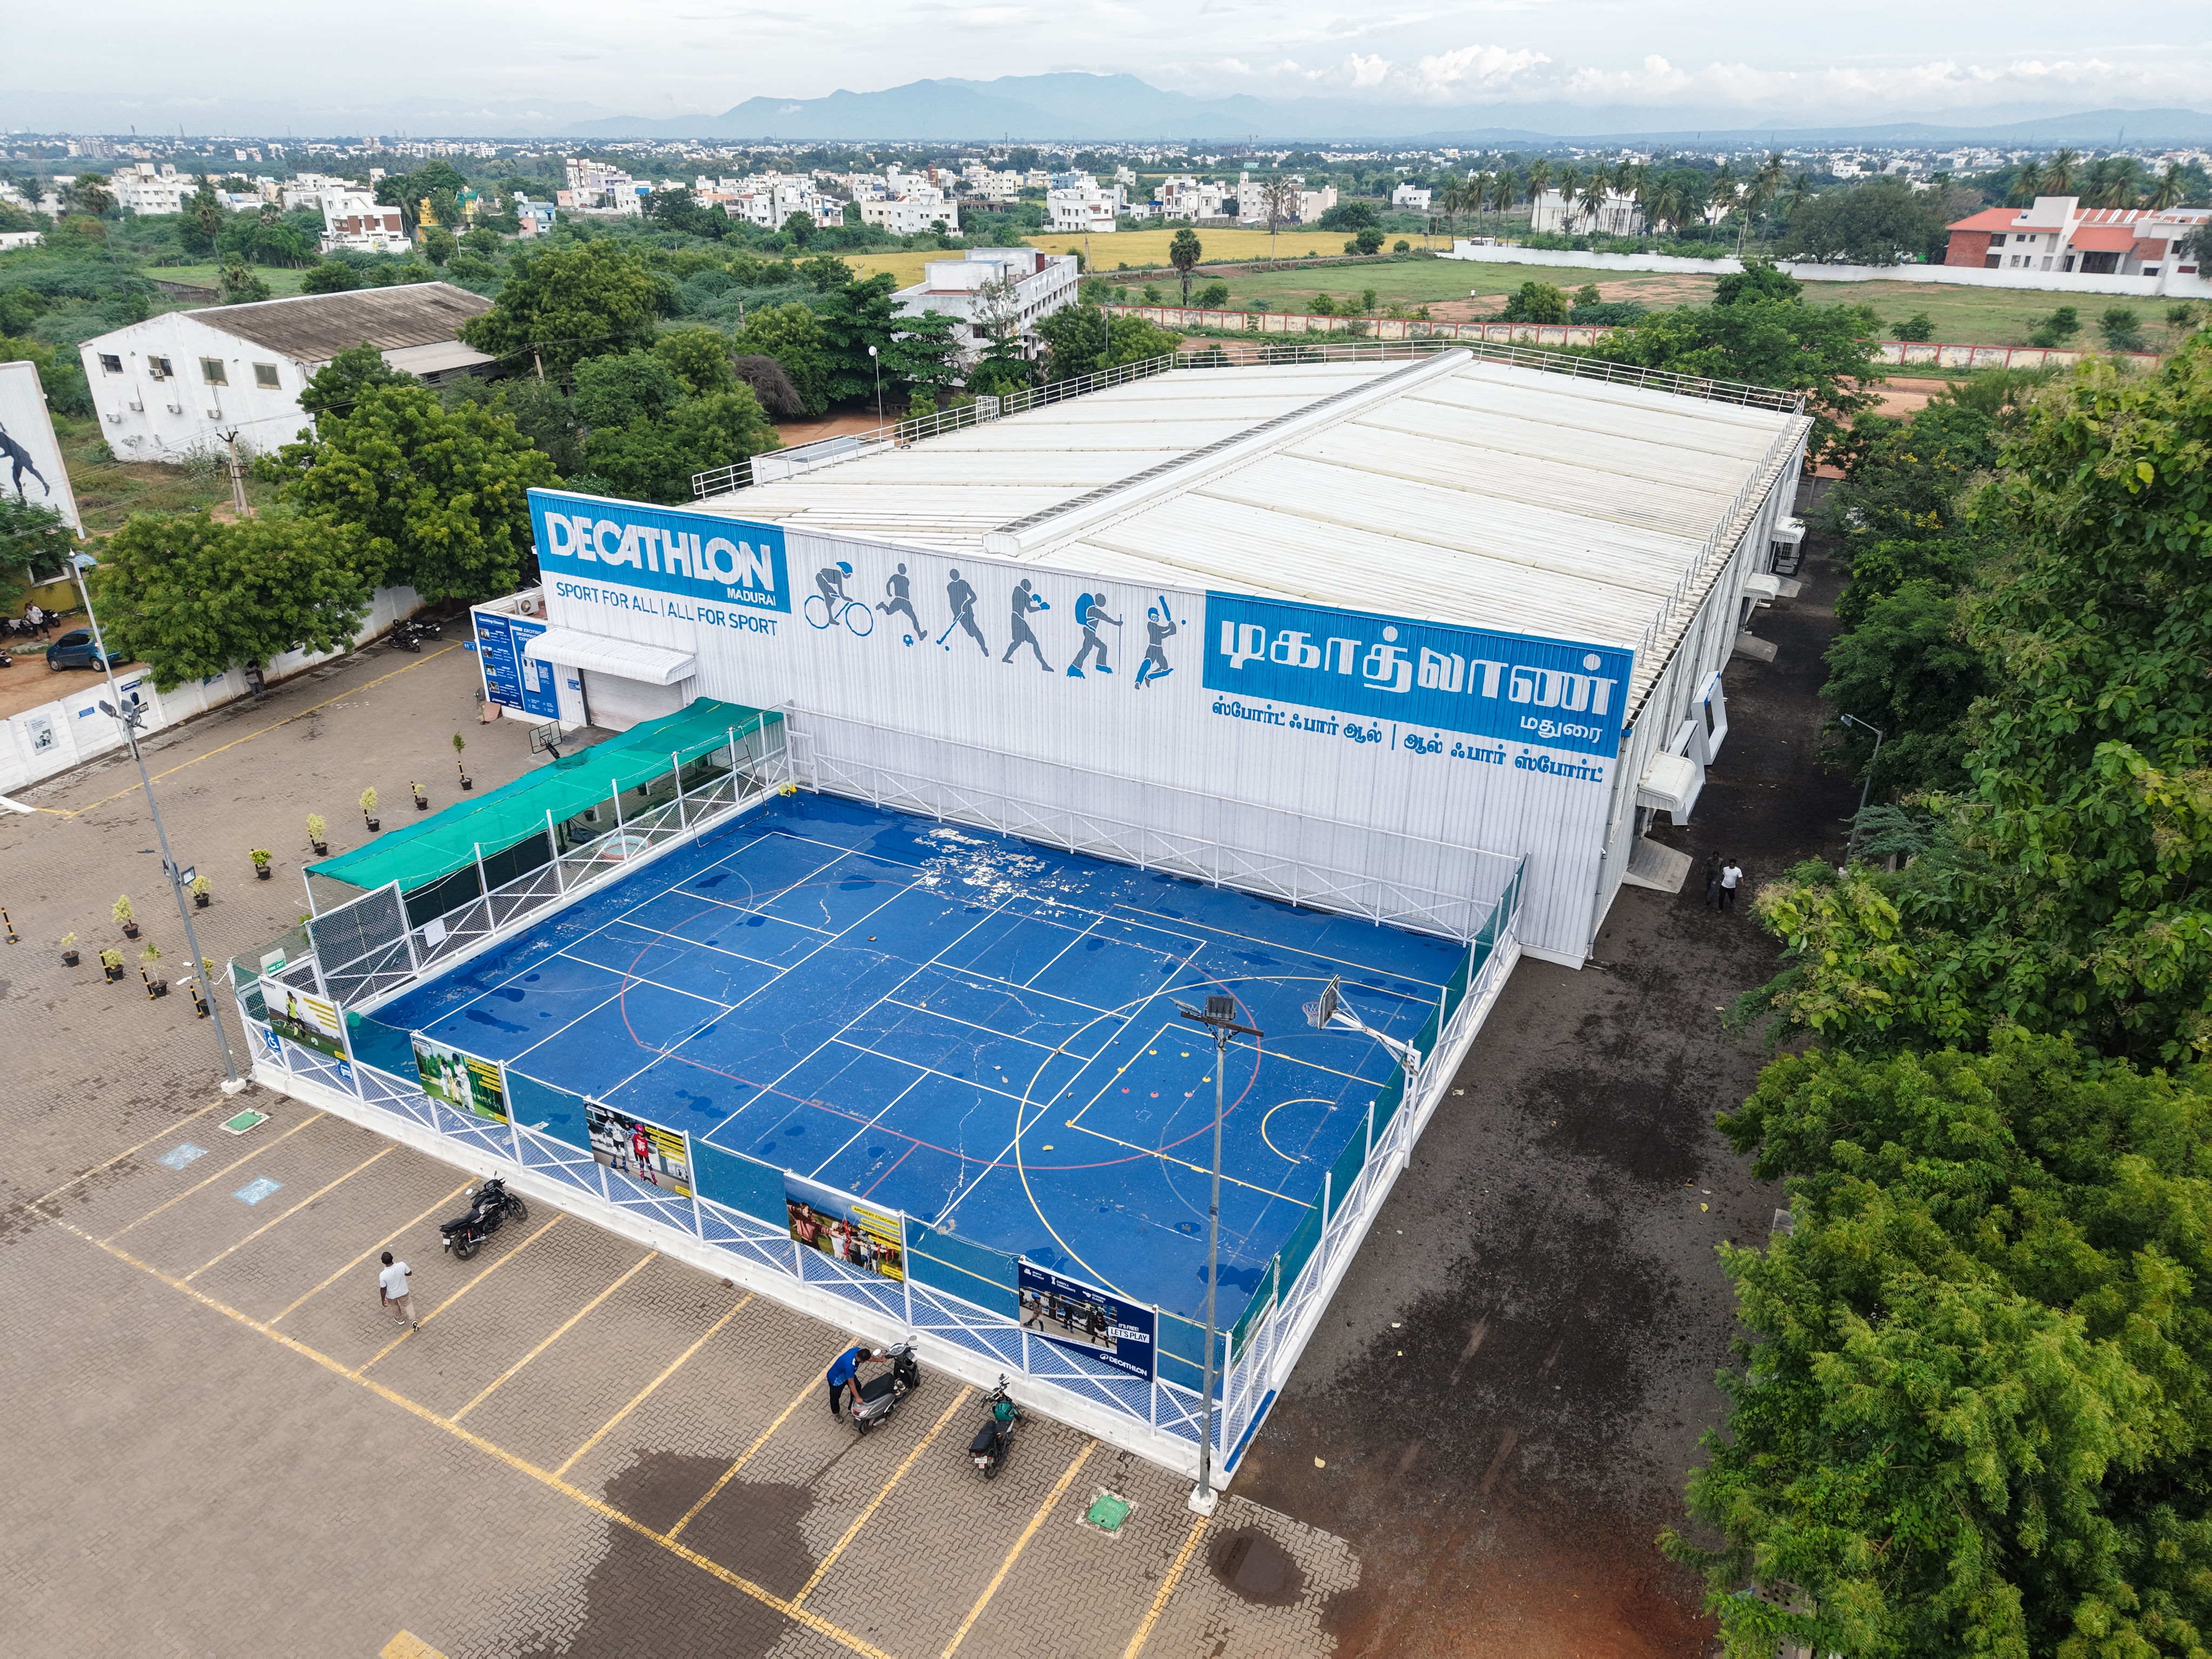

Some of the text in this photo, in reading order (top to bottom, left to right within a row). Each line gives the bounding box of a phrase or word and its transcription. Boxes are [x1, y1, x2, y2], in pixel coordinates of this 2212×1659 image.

[544, 511, 774, 591] DECATHLON
[556, 582, 598, 603] SPORT
[602, 590, 629, 609] FOR
[632, 595, 658, 615] ALL
[667, 602, 694, 621] ALL
[697, 606, 726, 627] FOR
[729, 612, 777, 636] SPORT
[727, 587, 777, 606] MADURAI
[1220, 620, 1618, 716] டிகாத்லாண்
[1212, 695, 1285, 726] ஸ்போர்ட்
[1289, 713, 1339, 736] ஃபார்
[1343, 721, 1382, 744] ஆல்
[1404, 732, 1443, 754] ஆல்
[1450, 743, 1507, 765] ஃபார்
[1514, 748, 1603, 783] ஸ்போர்ட்
[1520, 715, 1603, 743] மதுரை
[854, 1207, 899, 1226] ARCHERY COACHING
[1111, 1328, 1147, 1341] LET'S PLAY
[1109, 1356, 1147, 1377] DECATHLON
